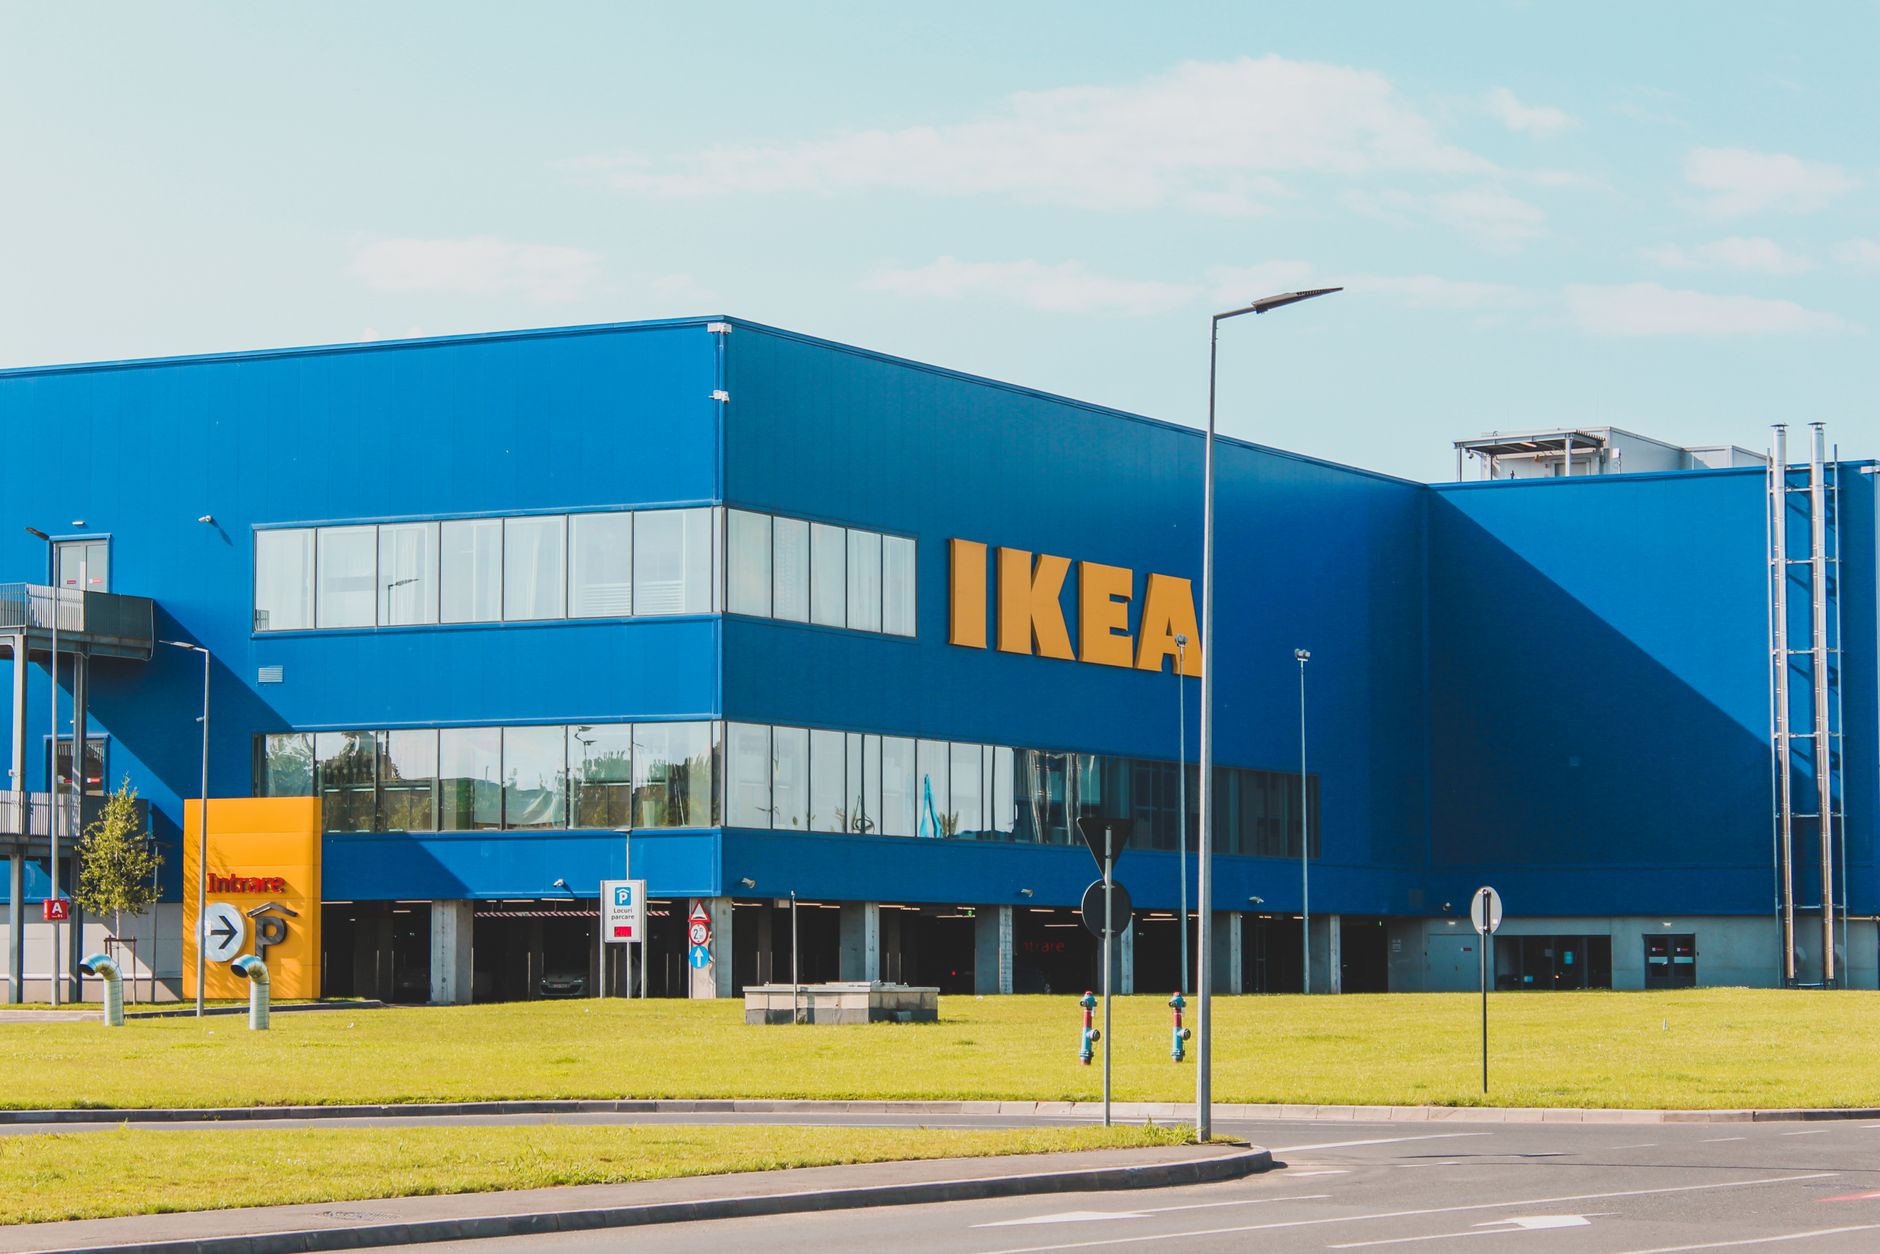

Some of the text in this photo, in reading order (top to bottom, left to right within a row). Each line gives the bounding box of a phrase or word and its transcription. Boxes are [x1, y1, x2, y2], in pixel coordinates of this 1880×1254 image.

[949, 538, 1203, 678] IKEA
[207, 873, 285, 893] Intrare
[52, 902, 62, 913] A
